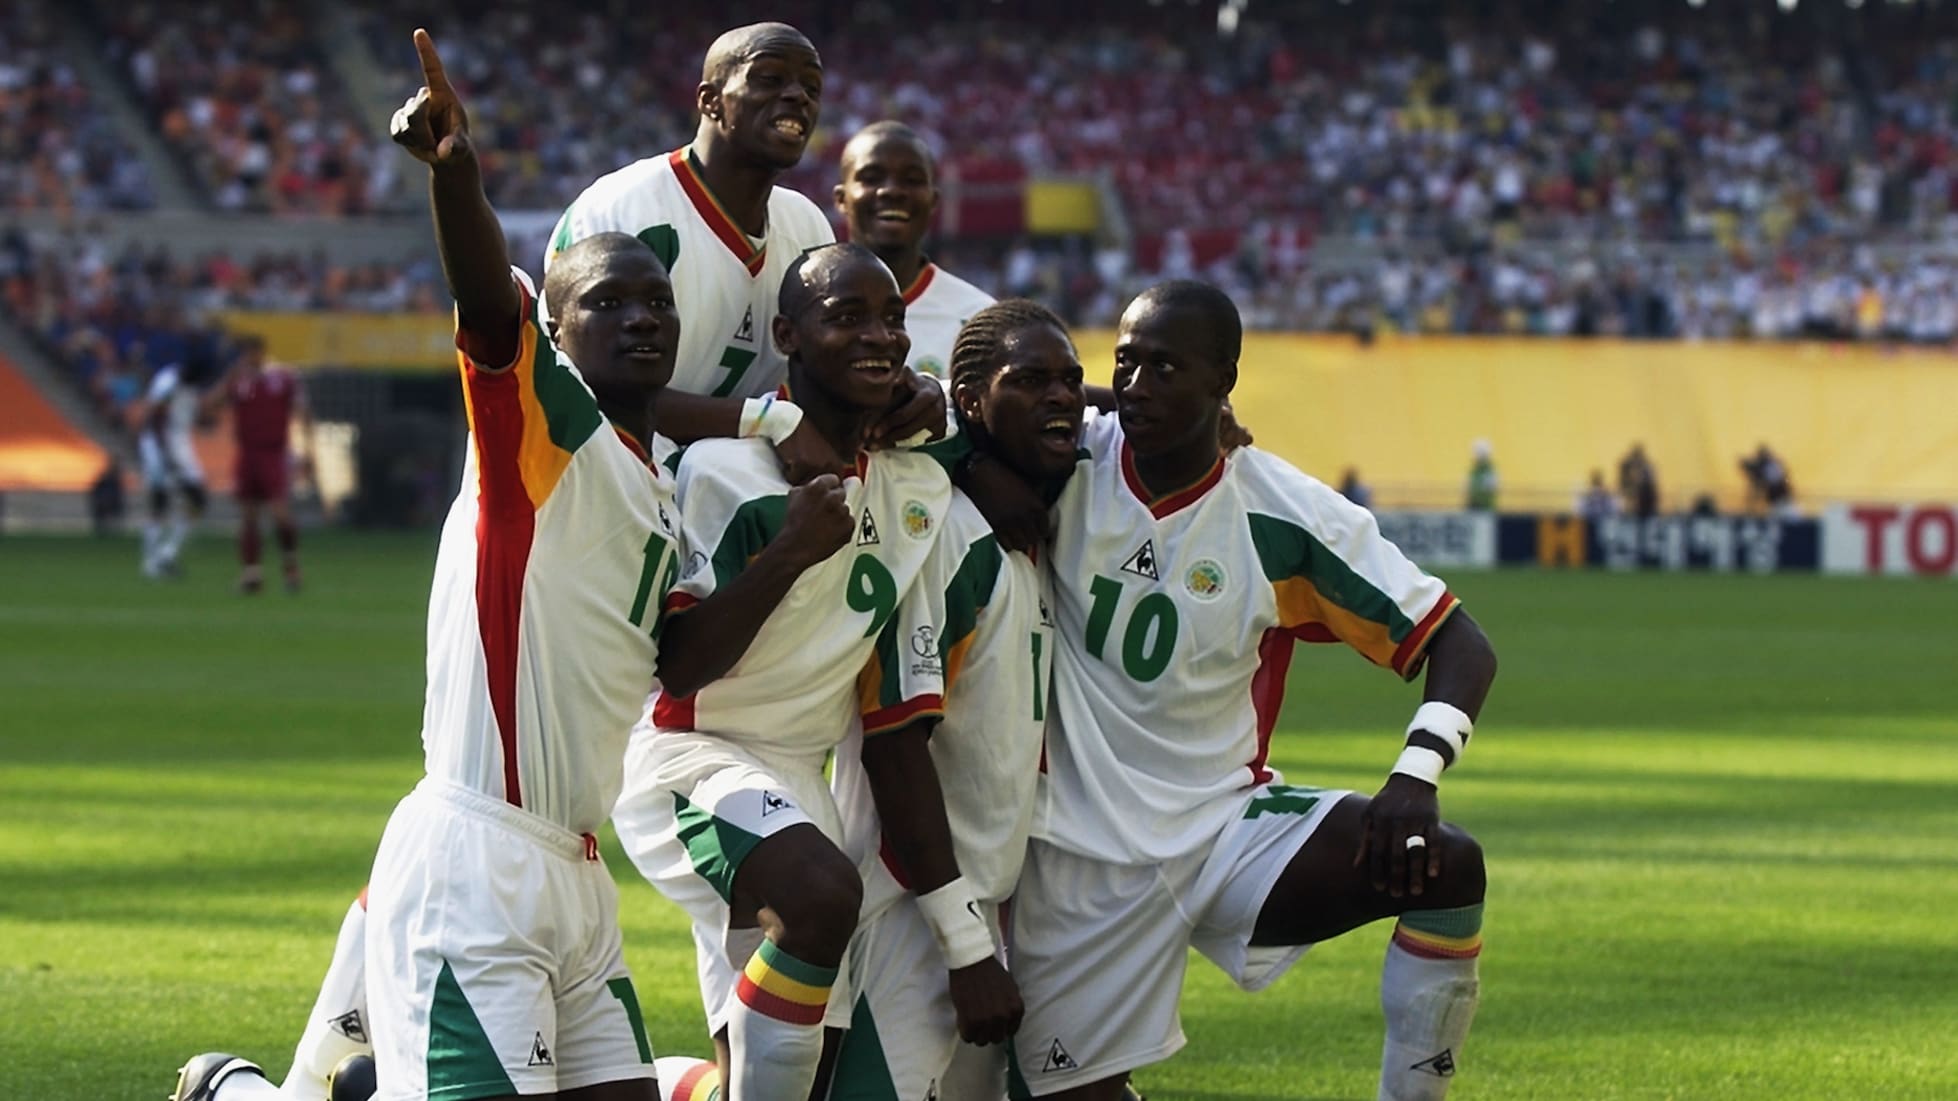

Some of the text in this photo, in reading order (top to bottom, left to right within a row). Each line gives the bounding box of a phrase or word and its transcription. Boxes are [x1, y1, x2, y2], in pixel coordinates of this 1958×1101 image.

[711, 346, 757, 397] 7
[846, 553, 897, 638] 9
[1085, 574, 1179, 683] 10
